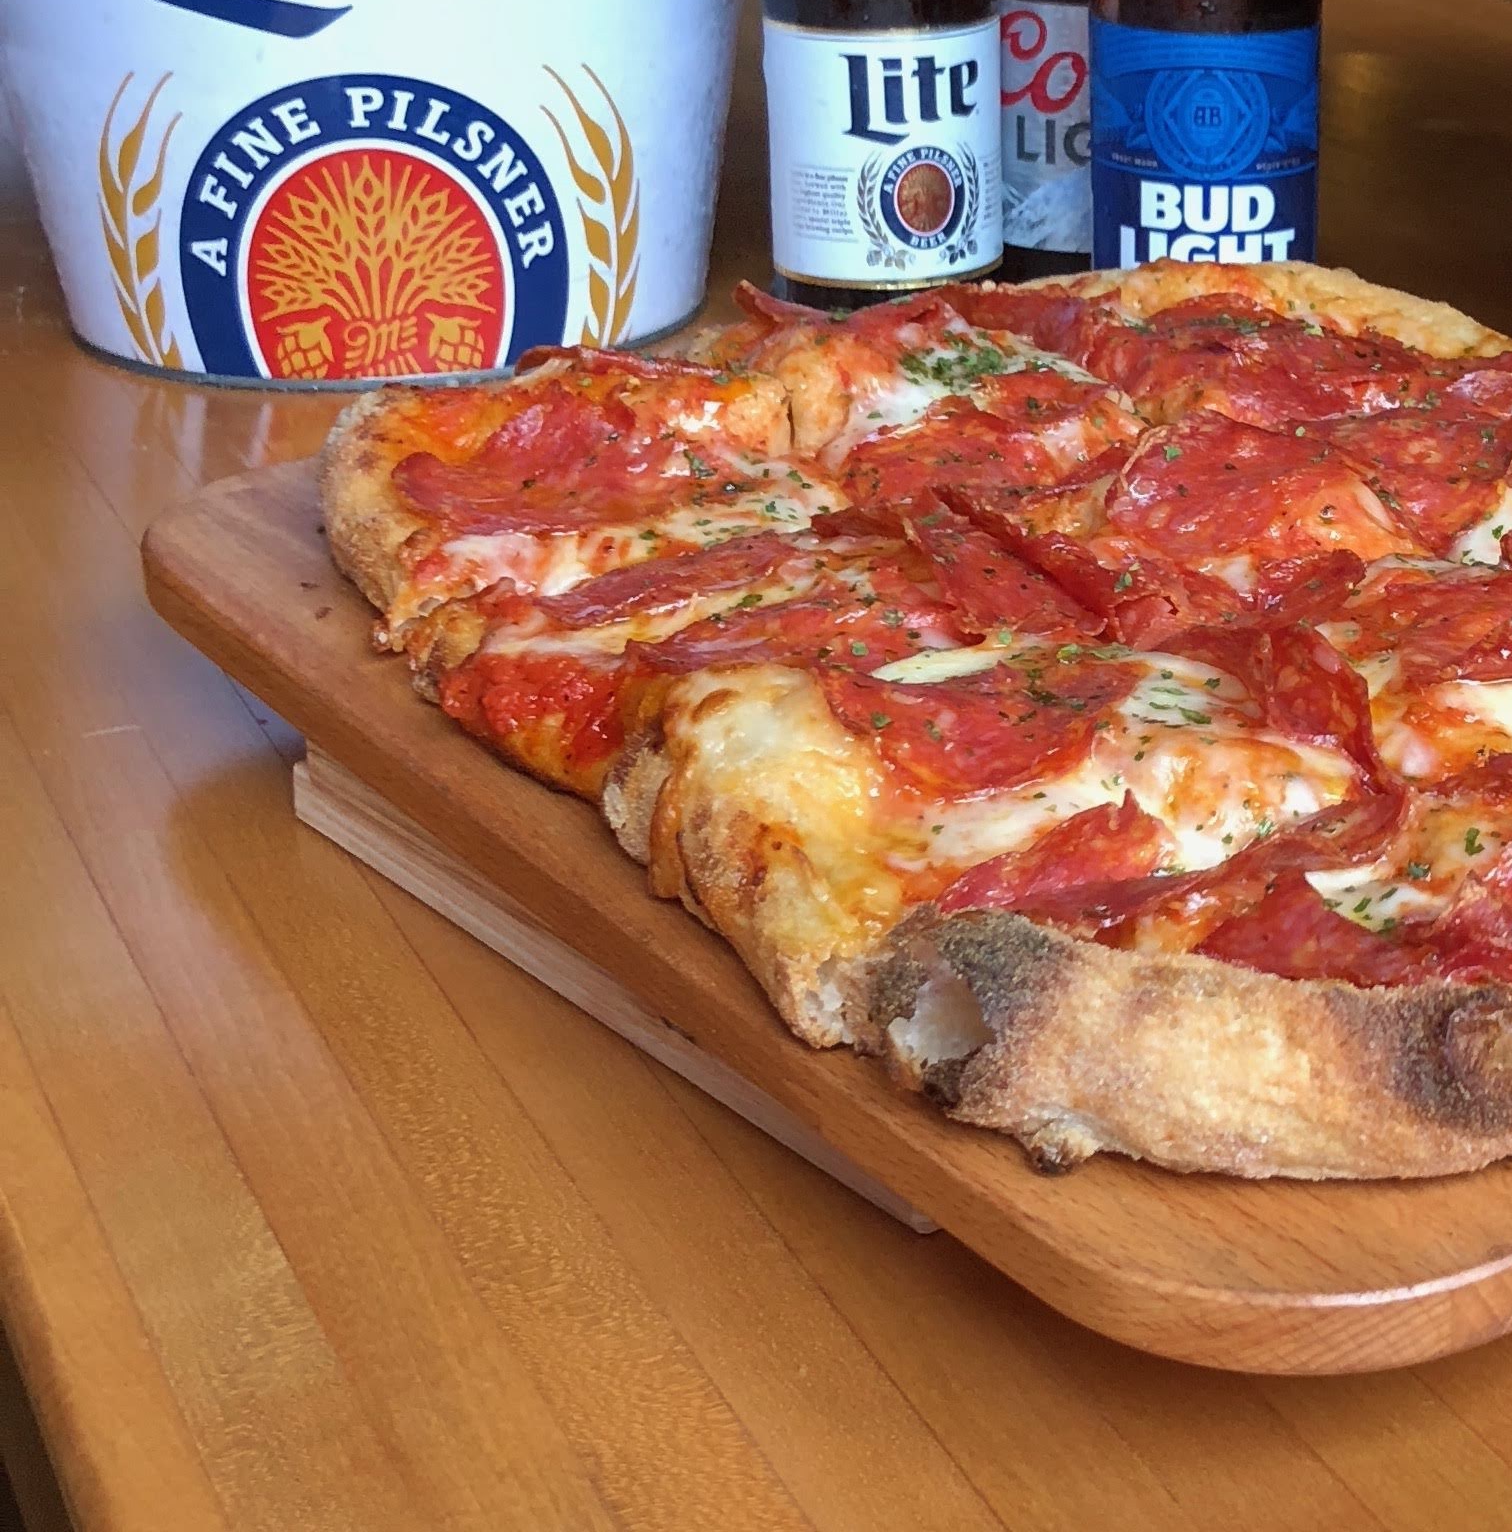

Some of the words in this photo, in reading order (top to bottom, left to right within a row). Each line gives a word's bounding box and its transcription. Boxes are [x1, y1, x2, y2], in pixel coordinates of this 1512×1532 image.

[839, 52, 979, 146] Lite
[199, 97, 322, 221] FINE
[343, 86, 555, 269] PILSNER
[1140, 180, 1276, 234] BUD
[191, 236, 229, 277] A
[1120, 224, 1296, 270] LIGHT
